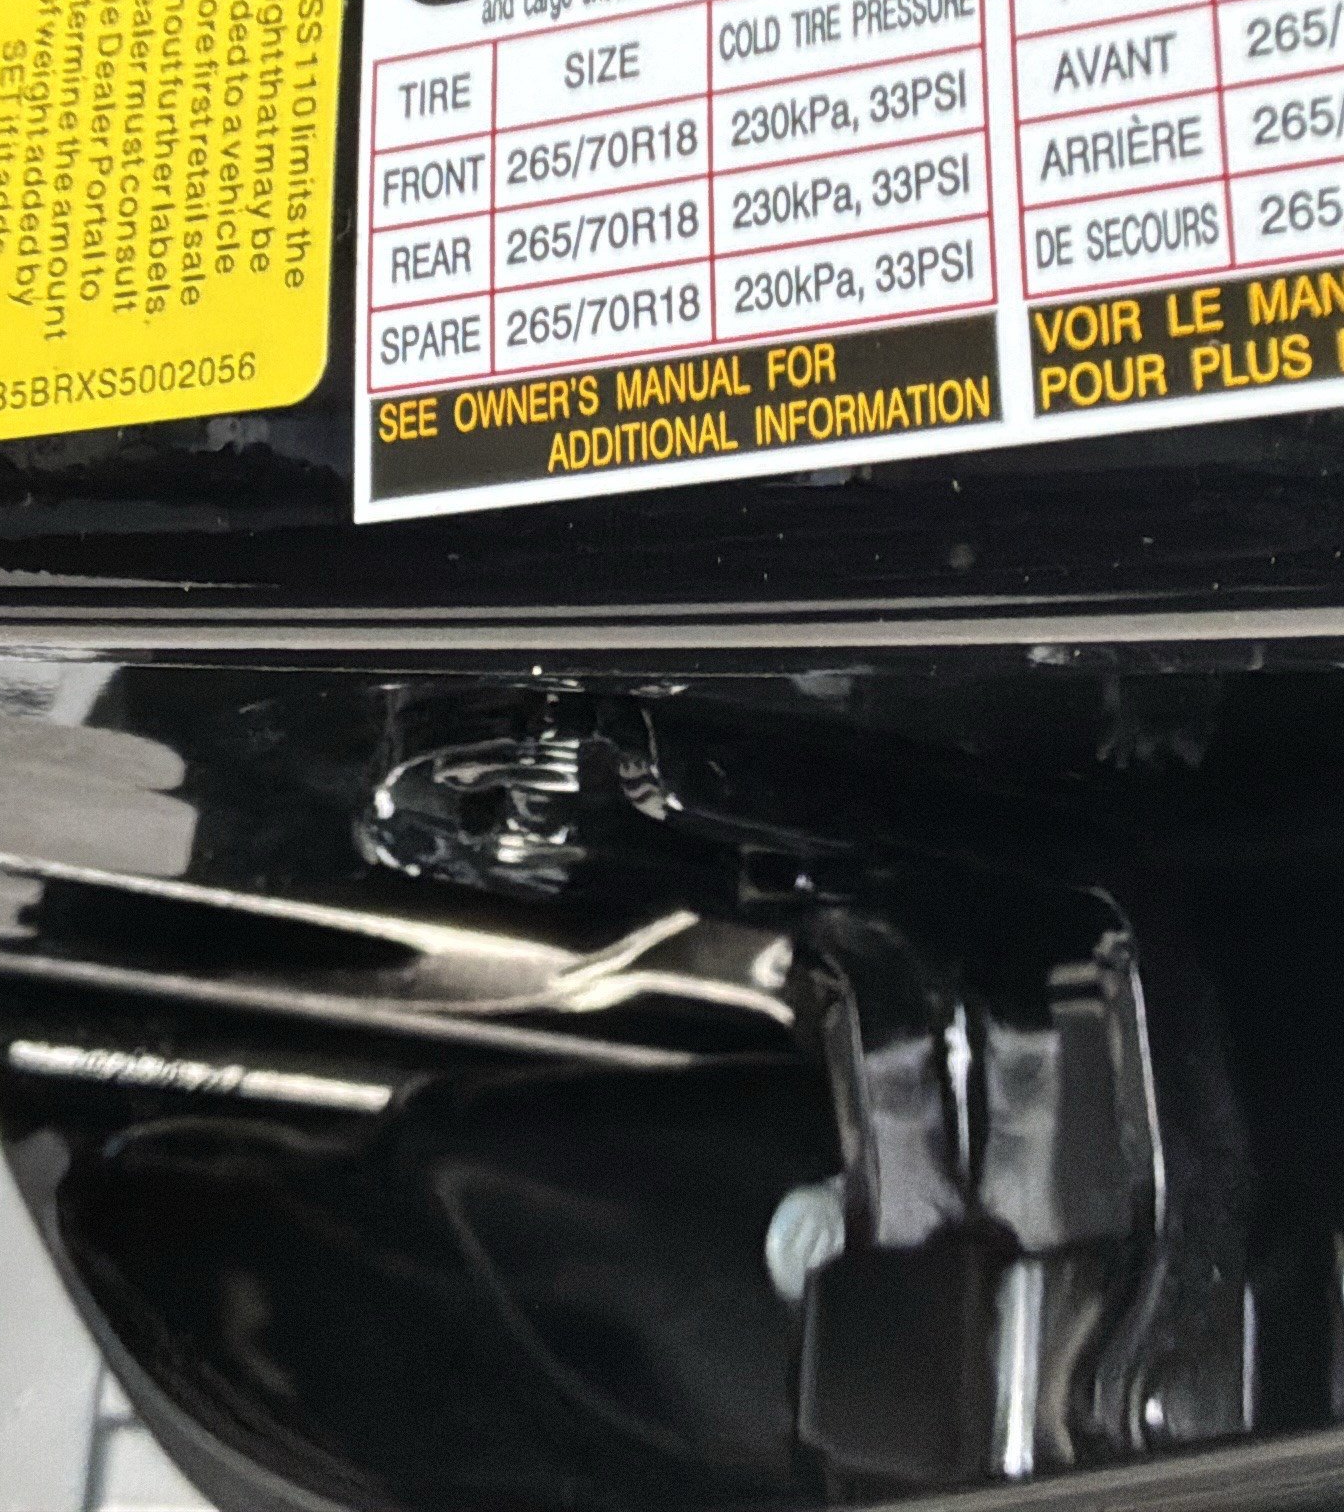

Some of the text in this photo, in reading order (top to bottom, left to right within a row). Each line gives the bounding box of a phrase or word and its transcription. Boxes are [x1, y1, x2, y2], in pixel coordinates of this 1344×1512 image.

[18, 20, 55, 140] weight
[89, 31, 124, 148] Dealer
[188, 57, 219, 129] first
[222, 70, 249, 108] to
[290, 51, 319, 119] 110
[397, 71, 471, 119] TIRE
[563, 40, 640, 90] SIZE
[717, 14, 781, 63] COLD
[789, 2, 841, 48] TIRE
[1052, 31, 1177, 93] AVANT
[120, 78, 147, 170] must
[151, 75, 184, 197] further
[221, 114, 242, 136] a
[254, 64, 285, 139] that
[52, 135, 81, 192] the
[183, 132, 210, 223] retail
[245, 142, 275, 219] may
[285, 122, 317, 223] limits
[382, 152, 486, 207] FRONT
[505, 117, 698, 186] 265/70R18
[1039, 113, 1204, 182] ARRIÈRE
[16, 144, 48, 257] added
[81, 153, 114, 260] Portal
[213, 139, 245, 274] vehicle
[1034, 223, 1074, 270] DE
[1085, 201, 1220, 263] SECOURS
[42, 198, 72, 341] amount
[111, 172, 140, 314] consult
[179, 229, 207, 306] sale
[248, 225, 276, 274] be
[282, 226, 312, 289] the
[390, 235, 472, 284] REAR
[505, 199, 699, 266] 265/70R18
[6, 262, 42, 307] by
[78, 265, 105, 302] to
[379, 313, 481, 366] SPARE
[505, 282, 701, 348] 265/70R18
[1033, 298, 1143, 354] VOIR
[1166, 285, 1225, 338] LE
[377, 340, 837, 443] SEE OWNER'S MANUAL FOR
[1038, 352, 1168, 410] POUR
[1190, 331, 1314, 391] PLUS
[547, 375, 992, 473] ADDITIONAL INFORMATION
